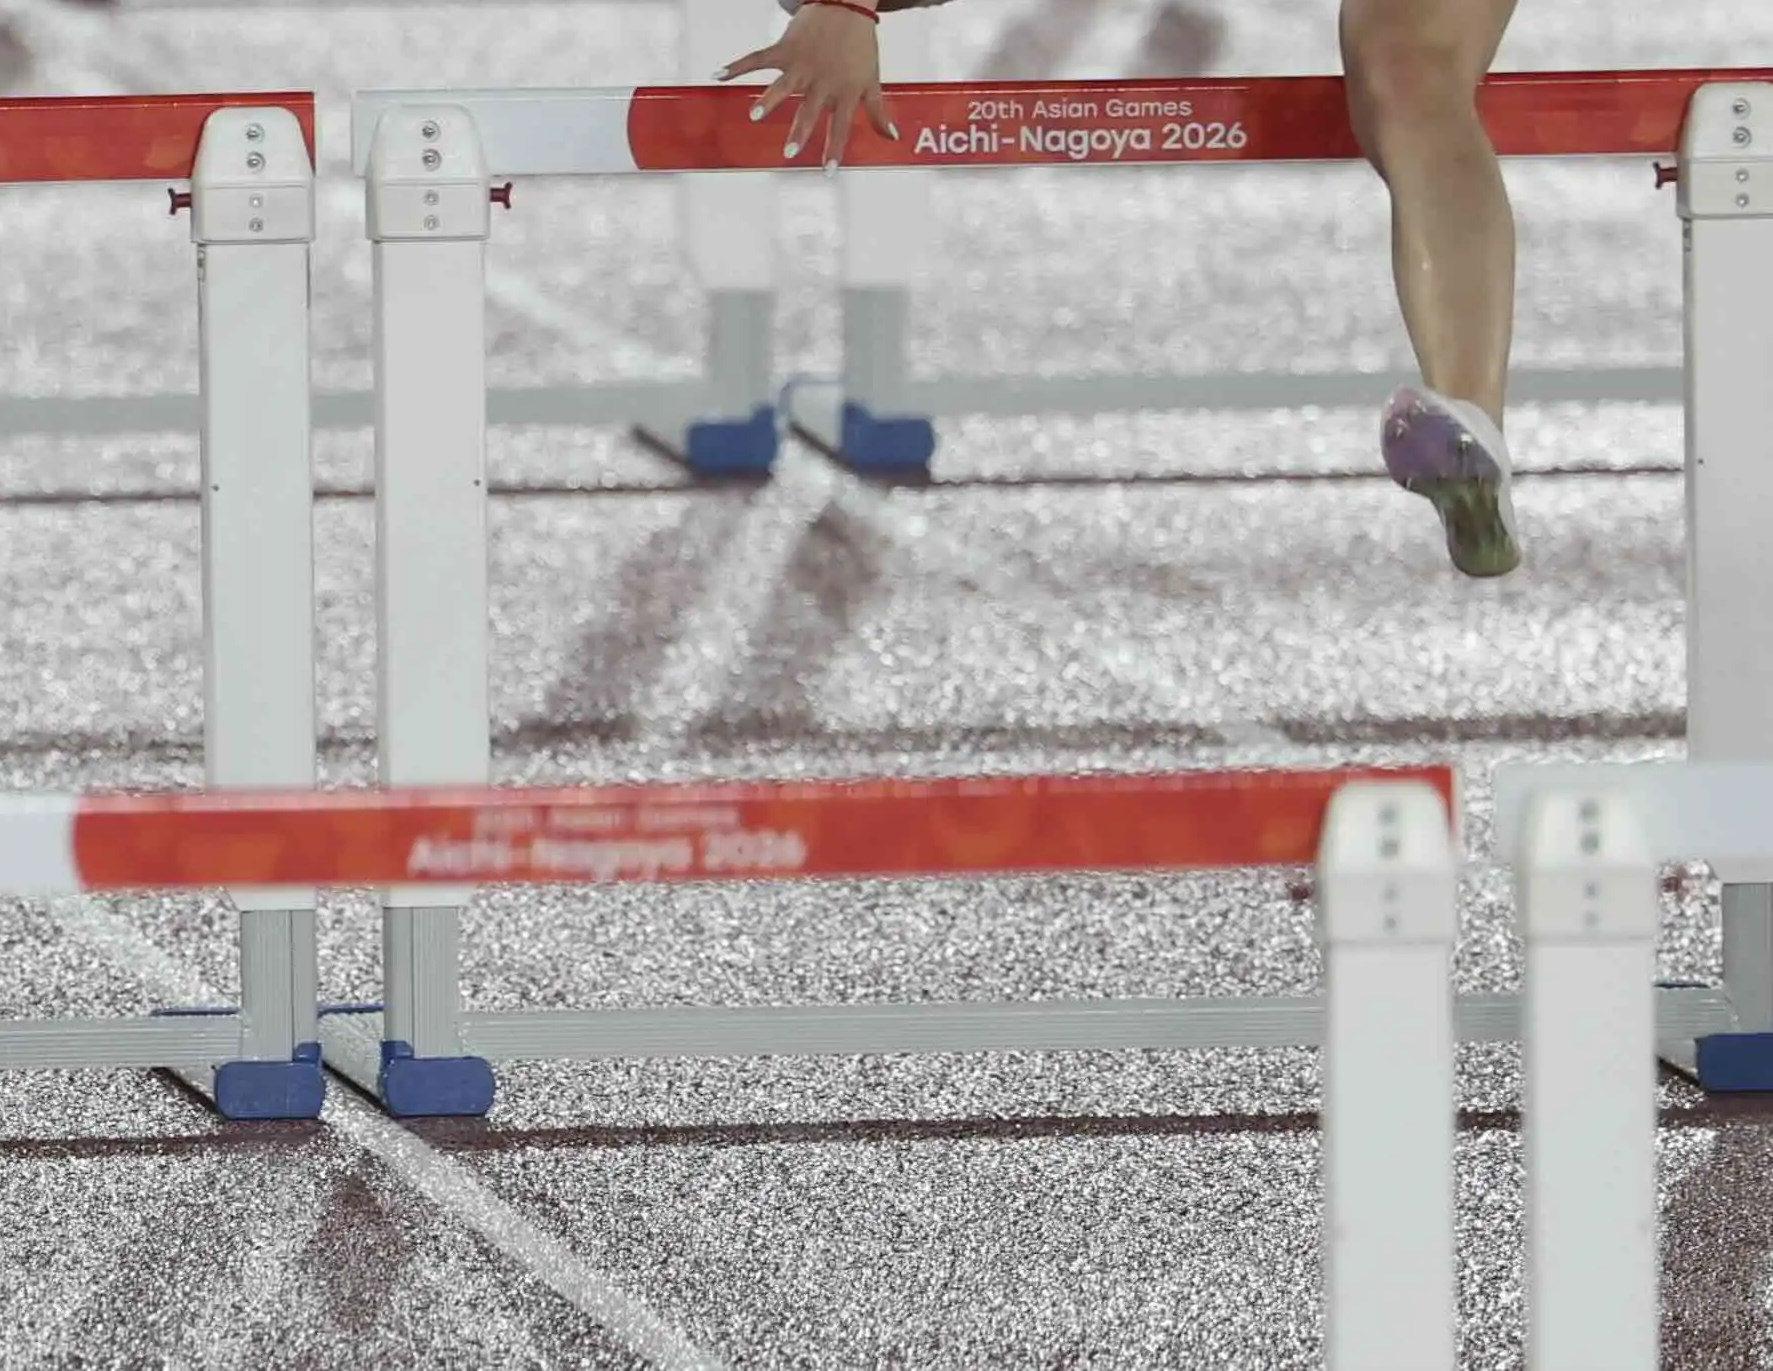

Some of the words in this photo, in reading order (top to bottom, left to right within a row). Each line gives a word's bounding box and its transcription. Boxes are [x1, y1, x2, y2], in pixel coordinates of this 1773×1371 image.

[968, 100, 1023, 120] 20th
[1032, 98, 1098, 119] Asian
[1106, 99, 1192, 117] Games
[914, 124, 1151, 160] Aichi-Nagoya
[1161, 122, 1248, 150] 2026
